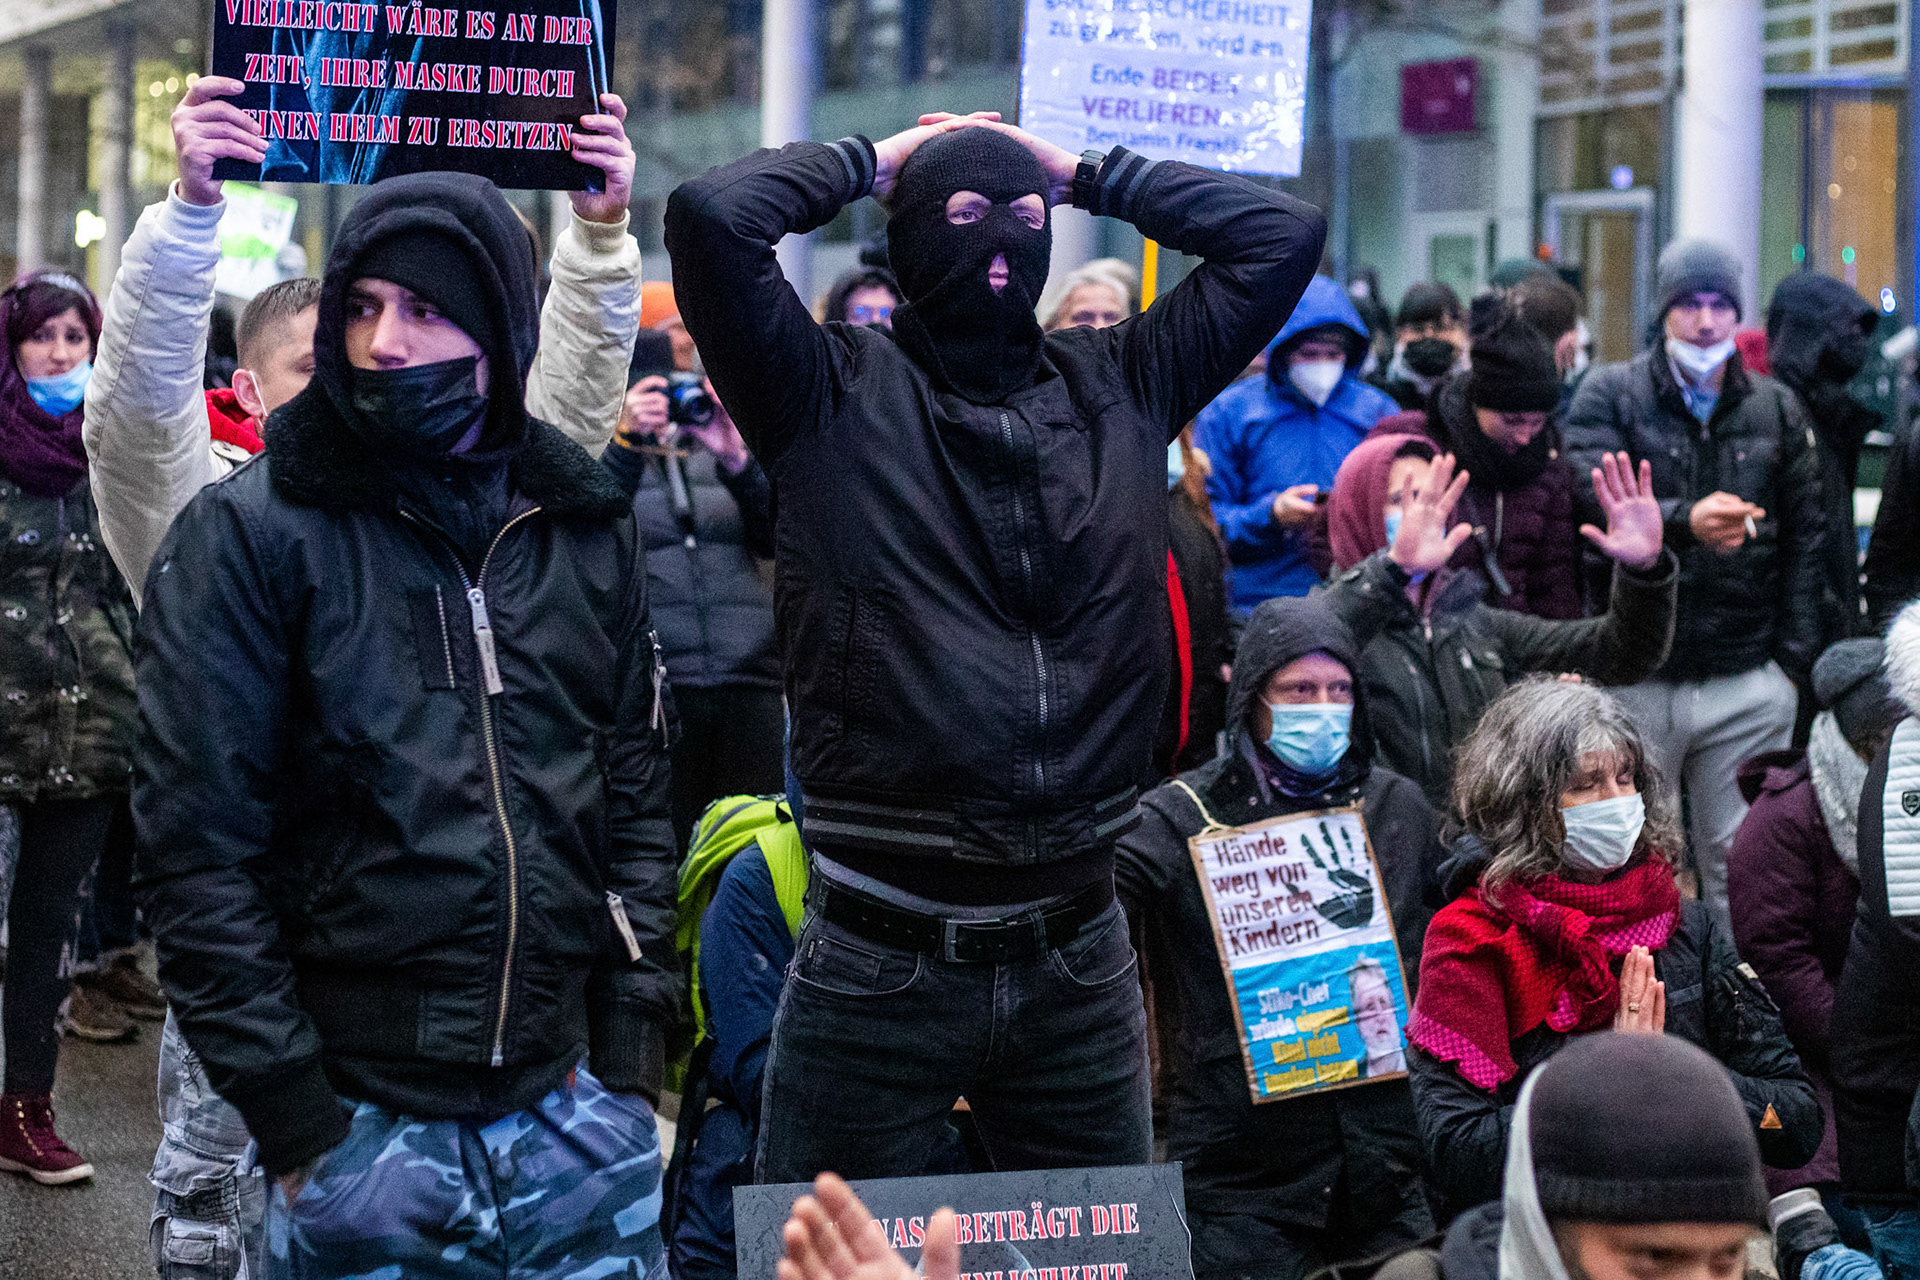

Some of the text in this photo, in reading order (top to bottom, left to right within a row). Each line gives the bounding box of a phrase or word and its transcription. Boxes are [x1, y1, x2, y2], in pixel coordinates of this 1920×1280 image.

[225, 0, 592, 45] VIELLEICHT WÄRE ES AN DER
[244, 53, 575, 98] ZEIT, IHRE MASKE DURCH
[1091, 63, 1144, 86] Ende
[242, 109, 322, 140] INEN
[329, 113, 401, 144] HELM
[407, 116, 441, 146] ZU
[1214, 831, 1287, 867] Hände
[1212, 861, 1309, 898] weg von
[1220, 888, 1318, 927] unseren
[1228, 917, 1320, 956] Kindern
[954, 1201, 1082, 1245] BETRÄGT
[1090, 1203, 1139, 1236] DIE
